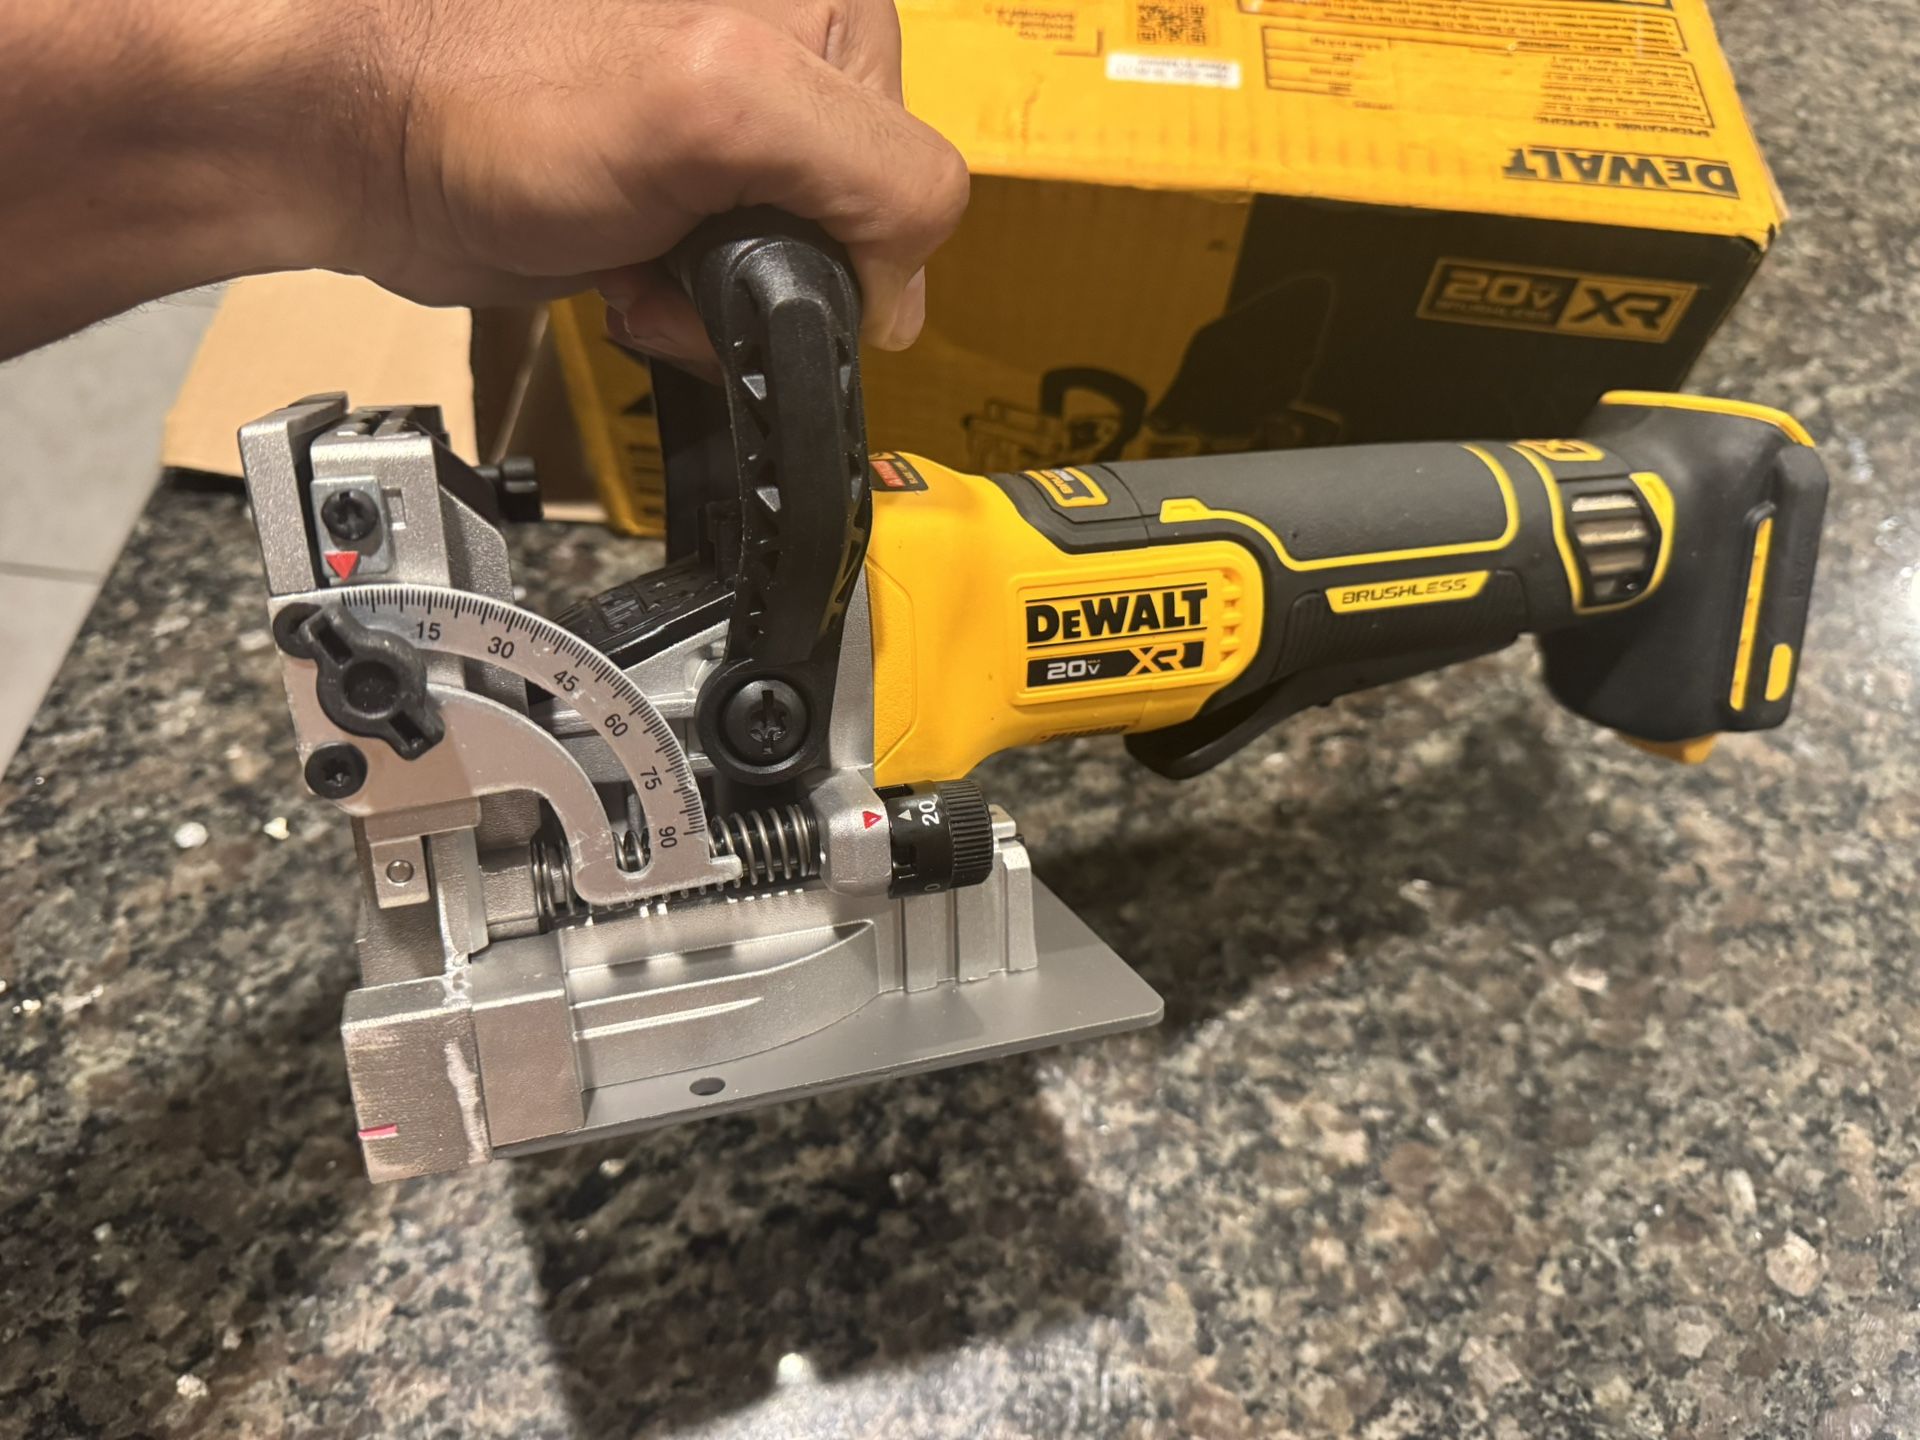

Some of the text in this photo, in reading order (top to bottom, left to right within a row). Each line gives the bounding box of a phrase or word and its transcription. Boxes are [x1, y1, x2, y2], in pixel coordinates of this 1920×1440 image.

[1500, 147, 1739, 194] DEWALT
[1570, 286, 1674, 331] XR
[1342, 578, 1467, 605] BRUSHLESS
[1025, 588, 1208, 644] DEWALT
[415, 620, 442, 641] 15
[487, 636, 515, 660] 30
[1126, 642, 1186, 677] XR
[553, 670, 580, 693] 45
[603, 712, 629, 738] 60
[640, 765, 663, 791] 75
[658, 825, 678, 849] 90
